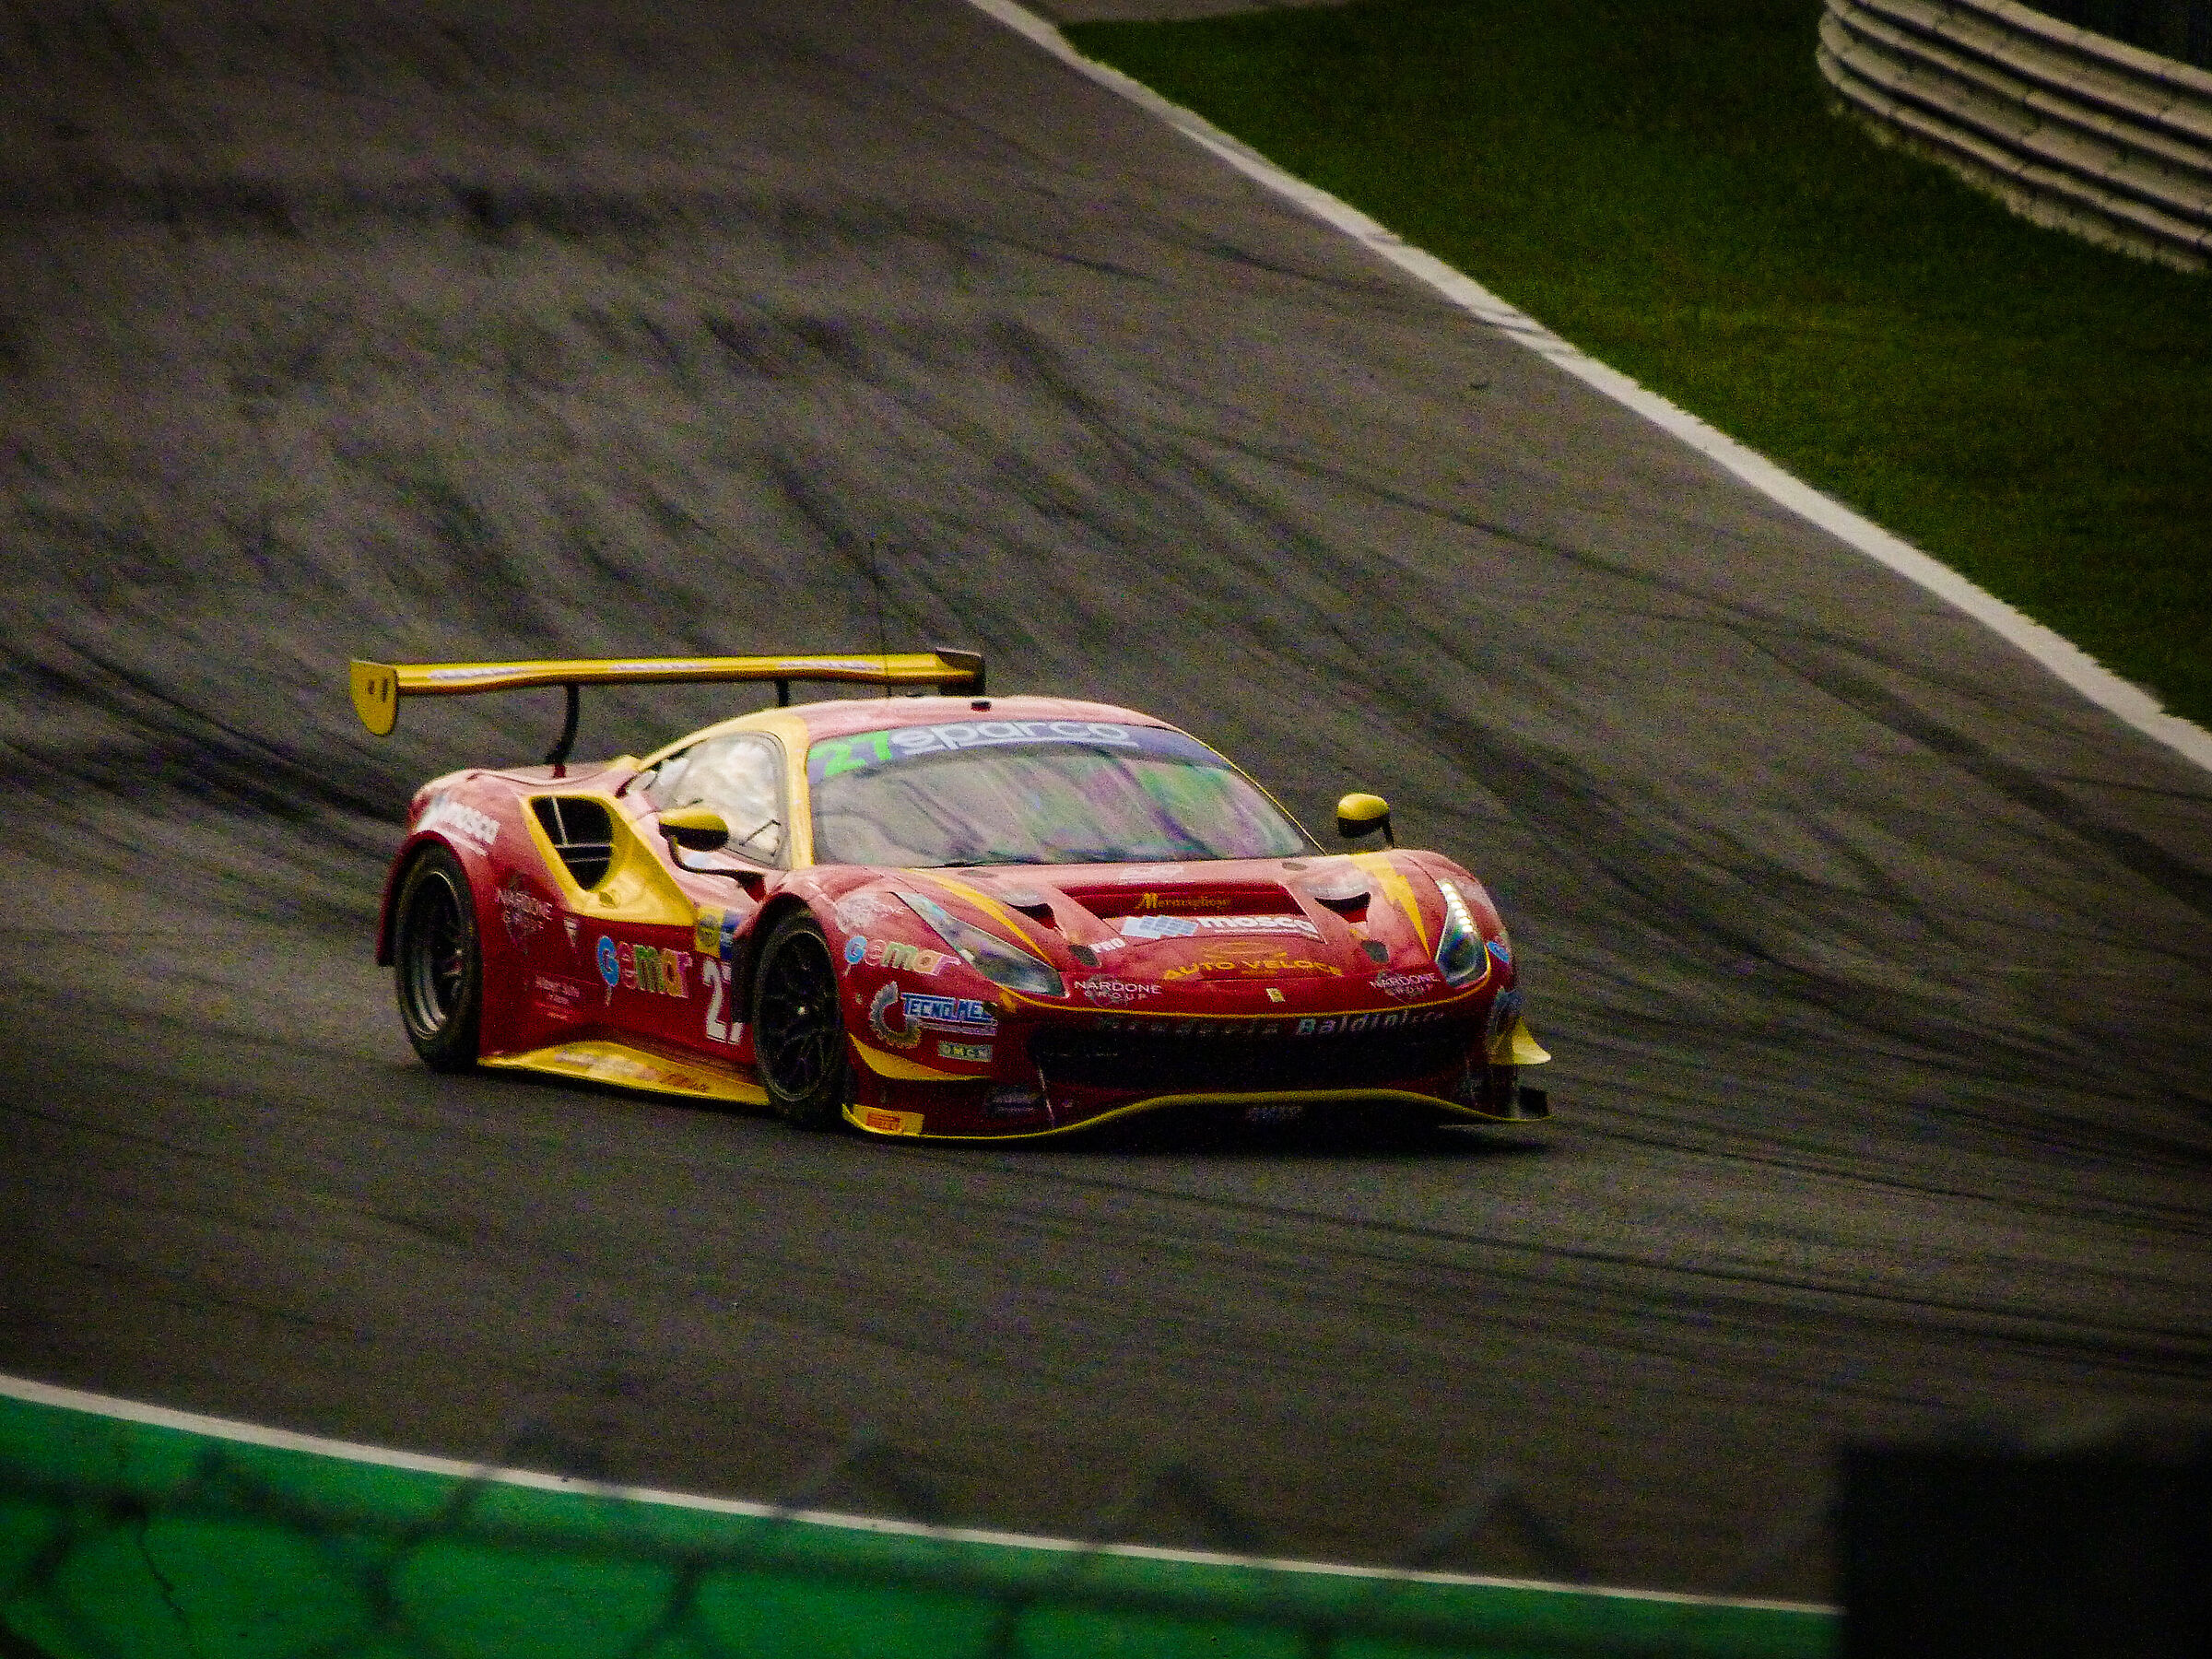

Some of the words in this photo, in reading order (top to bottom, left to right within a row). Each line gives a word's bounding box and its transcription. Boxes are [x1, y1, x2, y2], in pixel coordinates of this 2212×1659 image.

[807, 730, 893, 778] 27
[888, 720, 1135, 754] sparco
[843, 934, 961, 977] Gemar
[1088, 936, 1127, 954] PRO
[597, 934, 693, 1001] Gemar
[1162, 960, 1236, 980] AUTO
[1240, 959, 1345, 977] VELOCE
[1074, 980, 1162, 995] NARDONE
[1369, 970, 1441, 991] NARDONE
